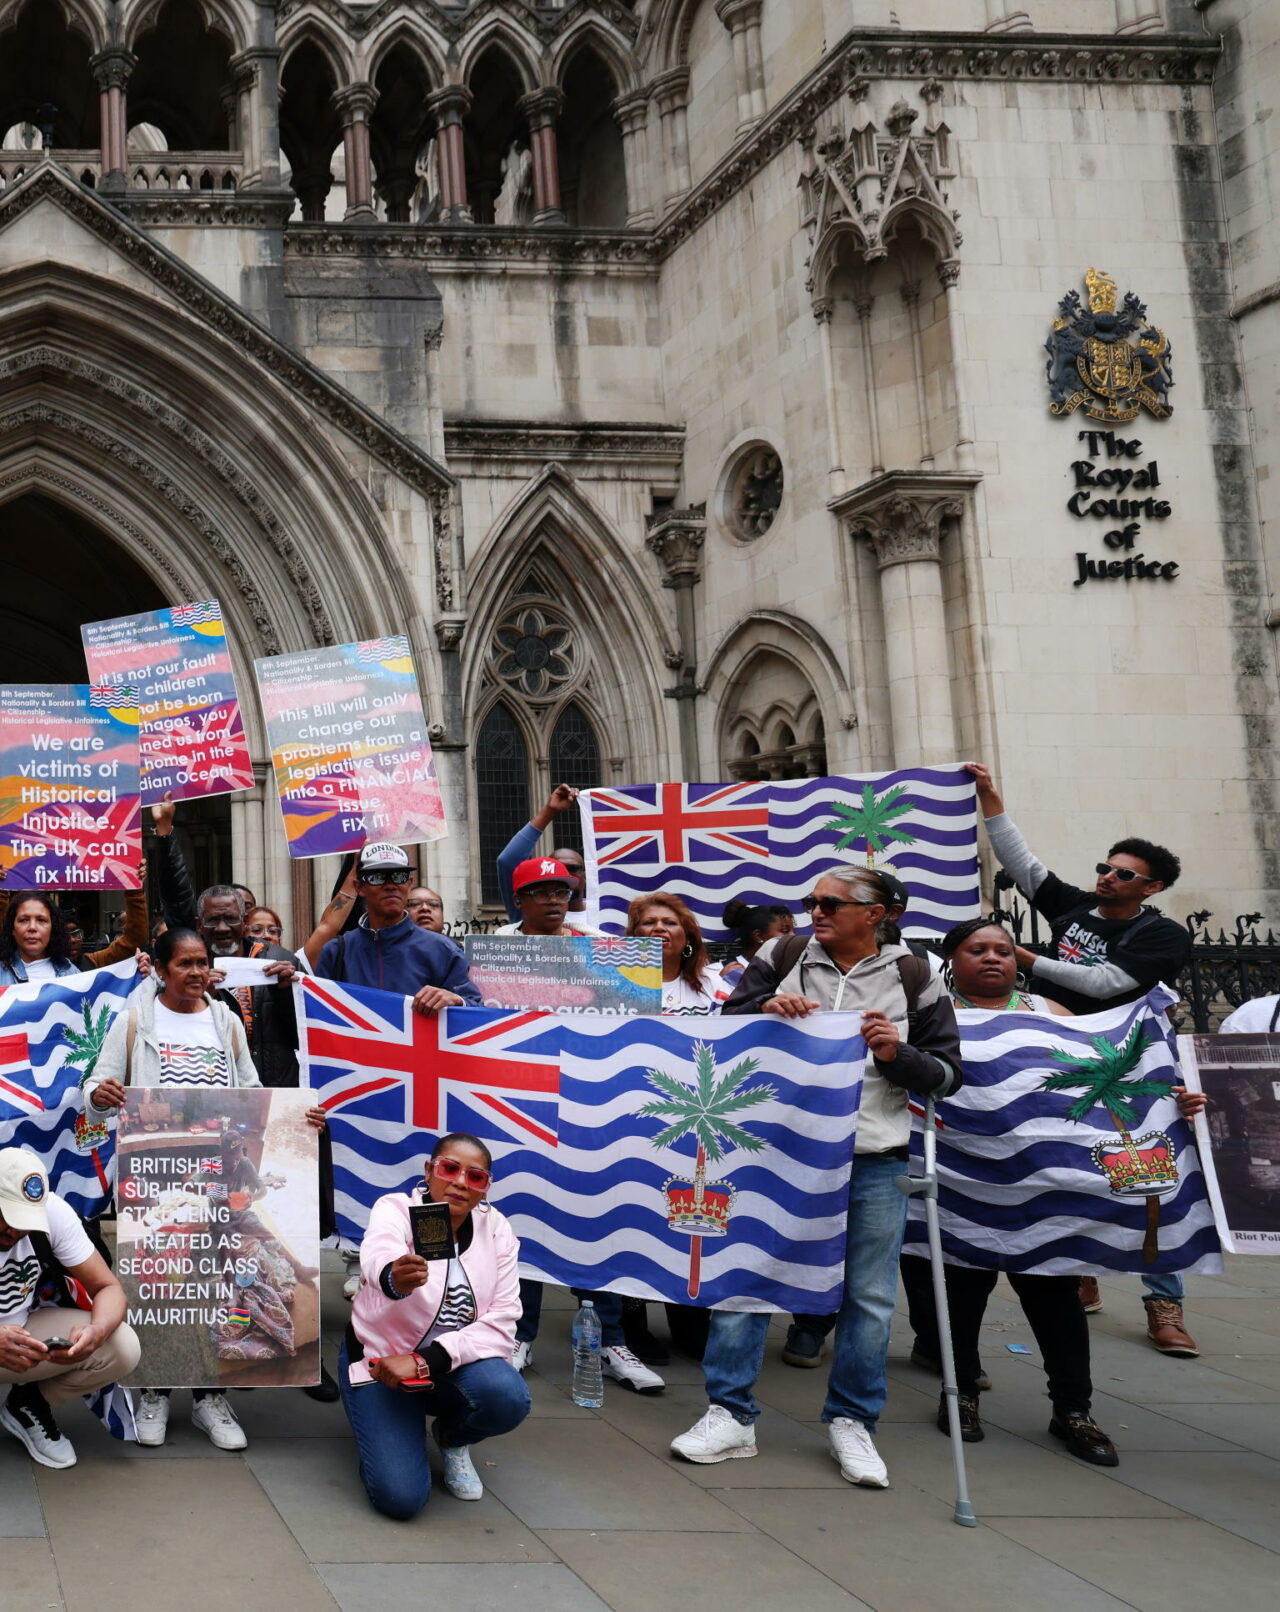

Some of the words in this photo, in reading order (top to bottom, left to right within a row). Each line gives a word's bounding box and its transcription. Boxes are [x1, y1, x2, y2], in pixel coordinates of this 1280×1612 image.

[1079, 431, 1143, 457] The
[1071, 461, 1161, 493] Royal
[1068, 491, 1172, 518] Courts
[1104, 522, 1140, 549] of
[1074, 553, 1180, 585] Justice
[112, 670, 124, 683] is
[128, 666, 152, 682] not
[156, 661, 179, 675] our
[183, 653, 217, 669] fault
[145, 675, 206, 696] children
[165, 697, 186, 711] be
[189, 691, 223, 706] born
[278, 709, 308, 723] This
[314, 703, 336, 718] Bill
[341, 697, 368, 713] will
[372, 692, 408, 709] only
[199, 710, 228, 727] you
[298, 720, 363, 739] change
[369, 715, 397, 728] our
[32, 734, 62, 751] We
[70, 737, 104, 751] are
[177, 734, 192, 746] us
[196, 728, 231, 744] from
[282, 739, 360, 764] problems
[365, 732, 404, 748] from
[410, 731, 421, 741] a
[145, 753, 189, 770] home
[192, 749, 206, 762] in
[210, 745, 234, 758] the
[288, 755, 374, 781] legislative
[379, 750, 421, 766] issue
[19, 760, 91, 777] victims
[99, 760, 118, 777] of
[176, 763, 233, 783] Ocean!
[285, 786, 317, 800] into
[322, 783, 334, 795] a
[339, 767, 433, 793] FINANCIAL
[21, 786, 116, 803] Historical
[339, 798, 386, 812] issue.
[23, 812, 115, 834] Injustice.
[342, 818, 367, 833] FIX
[373, 815, 390, 828] IT!
[11, 839, 47, 856] The
[55, 839, 80, 856] UK
[87, 842, 128, 856] can
[35, 866, 59, 883] fix
[66, 866, 105, 883] this!
[489, 943, 543, 952] September,
[473, 954, 523, 963] Nationality
[535, 955, 570, 963] Borders
[481, 964, 530, 974] Citizenship
[473, 975, 515, 983] Historical
[518, 976, 567, 985] Legislative
[571, 977, 619, 986] Unfairness
[130, 1157, 200, 1174] BRITISH
[134, 1234, 213, 1250] TREATED
[217, 1234, 242, 1250] AS
[1235, 1231, 1258, 1242] Riot
[119, 1258, 193, 1275] SECOND
[199, 1258, 258, 1275] CLASS
[139, 1283, 210, 1300] CITIZEN
[215, 1283, 233, 1299] IN
[127, 1308, 228, 1326] MAURITIUS
